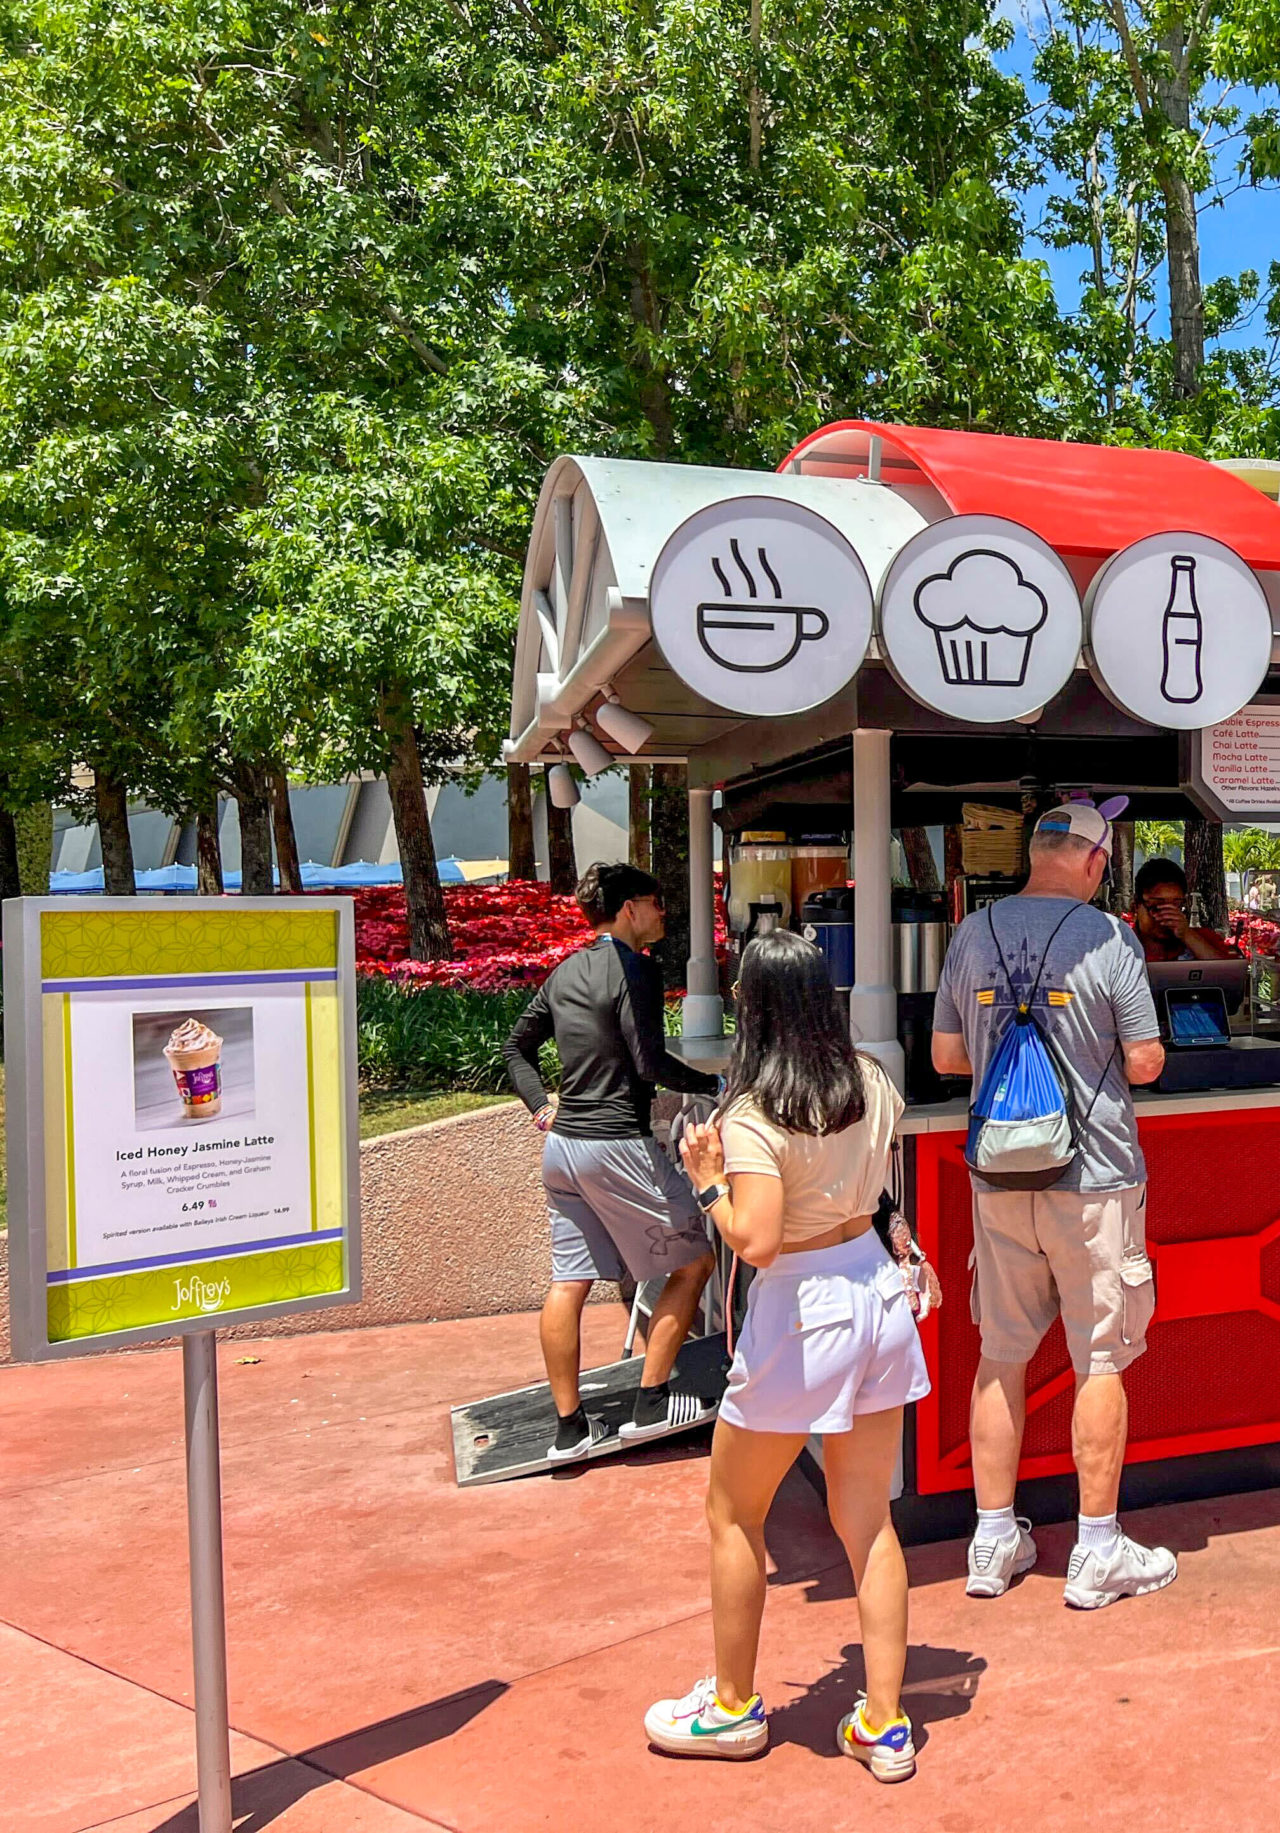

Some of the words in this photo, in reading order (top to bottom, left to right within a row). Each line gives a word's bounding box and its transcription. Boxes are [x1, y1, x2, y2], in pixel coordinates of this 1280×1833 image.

[1236, 730, 1260, 739] Latte
[1212, 741, 1232, 749] Chai
[1234, 741, 1258, 750] Latte
[1212, 752, 1242, 761] Mocha
[1244, 753, 1269, 762] Latte
[1212, 764, 1242, 773] Vanilla
[1244, 764, 1269, 773] Latte
[1212, 776, 1249, 785] Caramel
[1251, 776, 1276, 785] Latte
[116, 1148, 143, 1161] Iced
[147, 1145, 189, 1160] Honey
[192, 1139, 241, 1153] Jasmine
[244, 1135, 275, 1147] Latte
[129, 1169, 148, 1177] floral
[149, 1166, 172, 1175] fusion
[173, 1164, 182, 1172] of
[167, 1174, 201, 1184] Whipped
[229, 1168, 243, 1176] and
[244, 1164, 272, 1174] Graham
[167, 1185, 195, 1194] Cracker
[196, 1180, 231, 1191] Crumbles
[181, 1201, 205, 1212] 6.49
[102, 1230, 128, 1240] Spirited
[129, 1227, 151, 1235] version
[152, 1223, 179, 1232] available
[179, 1220, 193, 1228] with
[171, 1275, 231, 1311] Joffrey's
